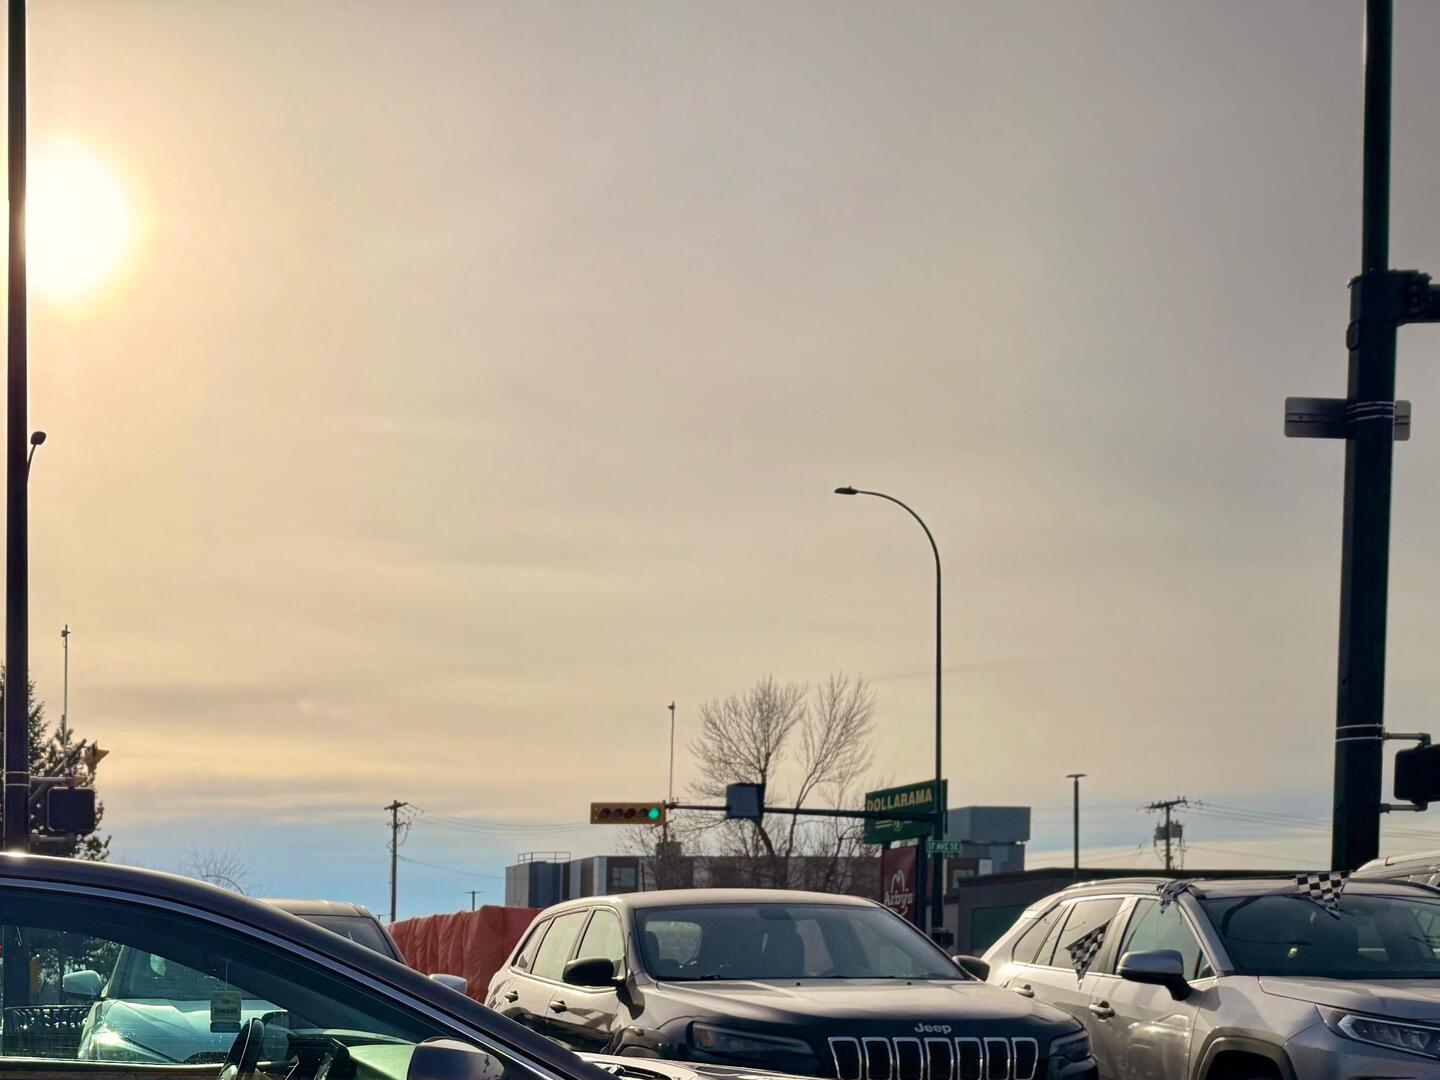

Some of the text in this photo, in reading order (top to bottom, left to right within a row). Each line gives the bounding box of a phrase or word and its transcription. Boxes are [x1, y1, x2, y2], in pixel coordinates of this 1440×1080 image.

[866, 788, 933, 812] DOLLARAMA
[884, 888, 913, 909] Arby's
[914, 1022, 952, 1034] Jeep
